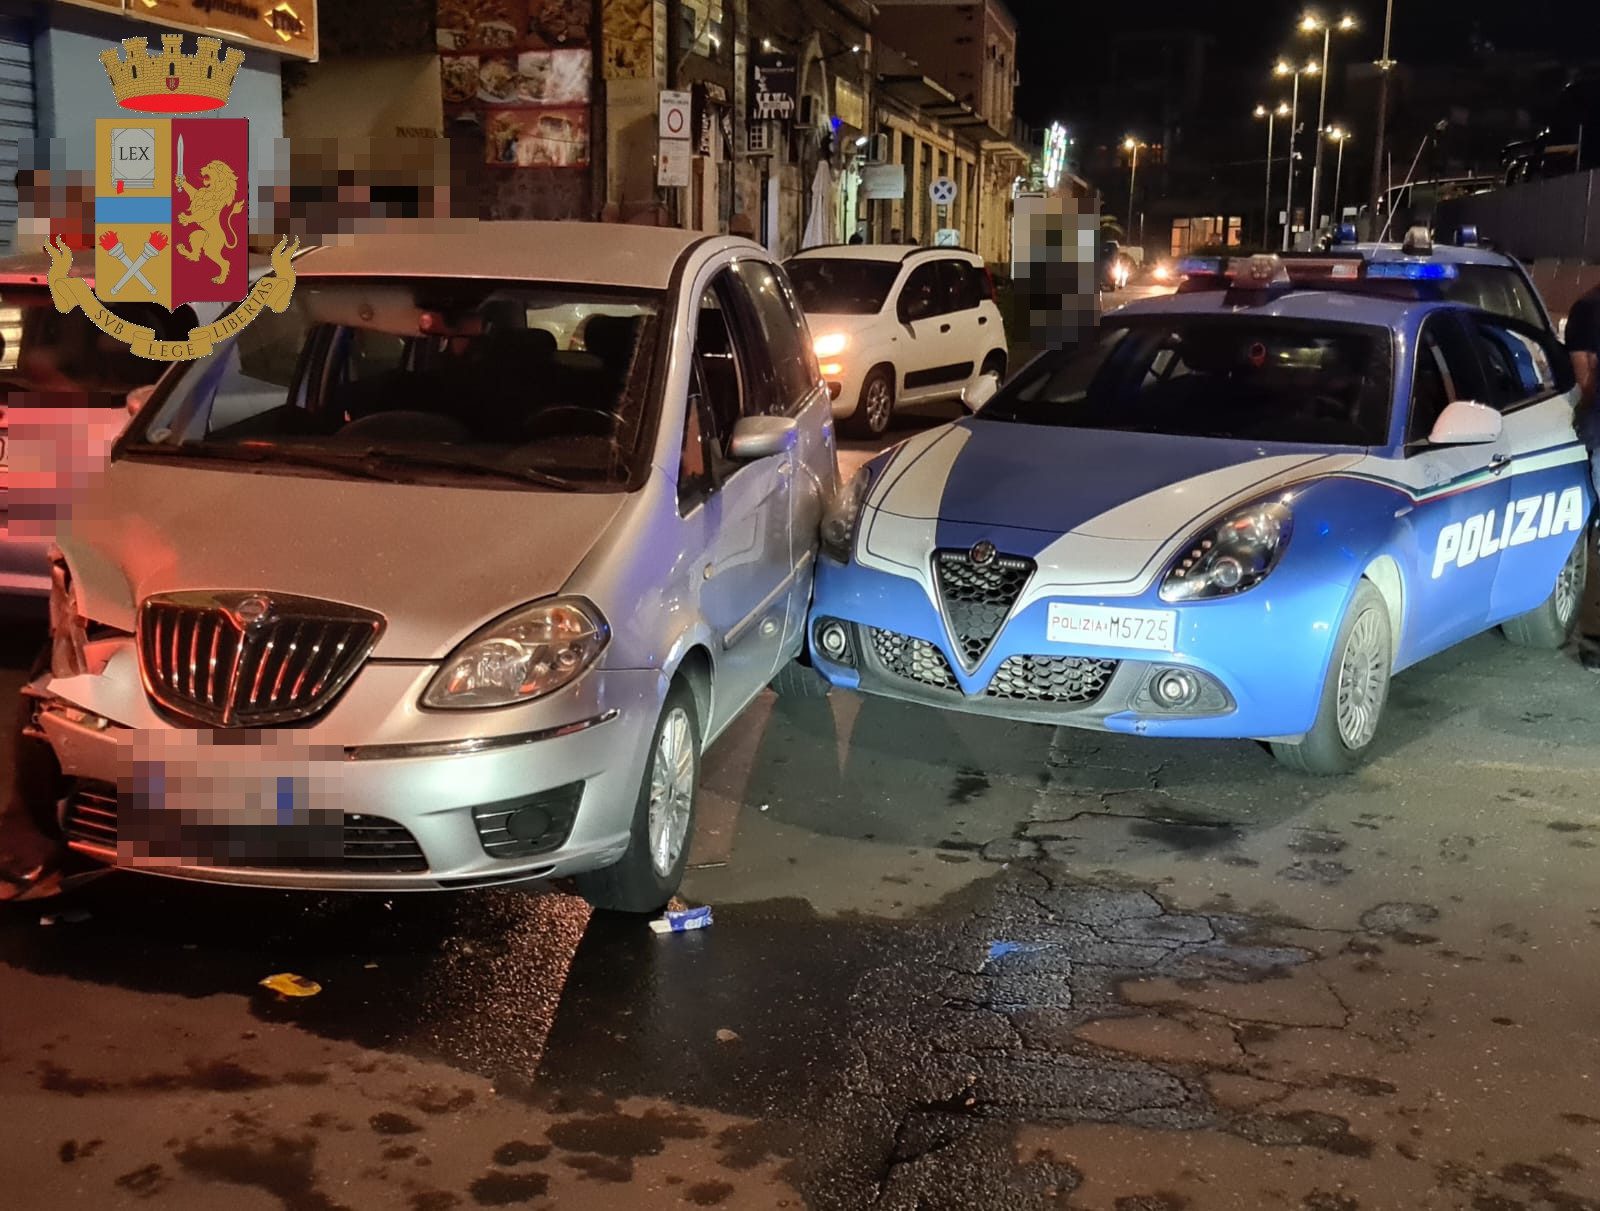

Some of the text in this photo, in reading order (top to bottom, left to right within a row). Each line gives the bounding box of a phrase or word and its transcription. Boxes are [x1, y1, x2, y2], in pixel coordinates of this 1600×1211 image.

[1431, 486, 1583, 580] POLIZIA
[1052, 616, 1168, 641] POLIZIA M5725
